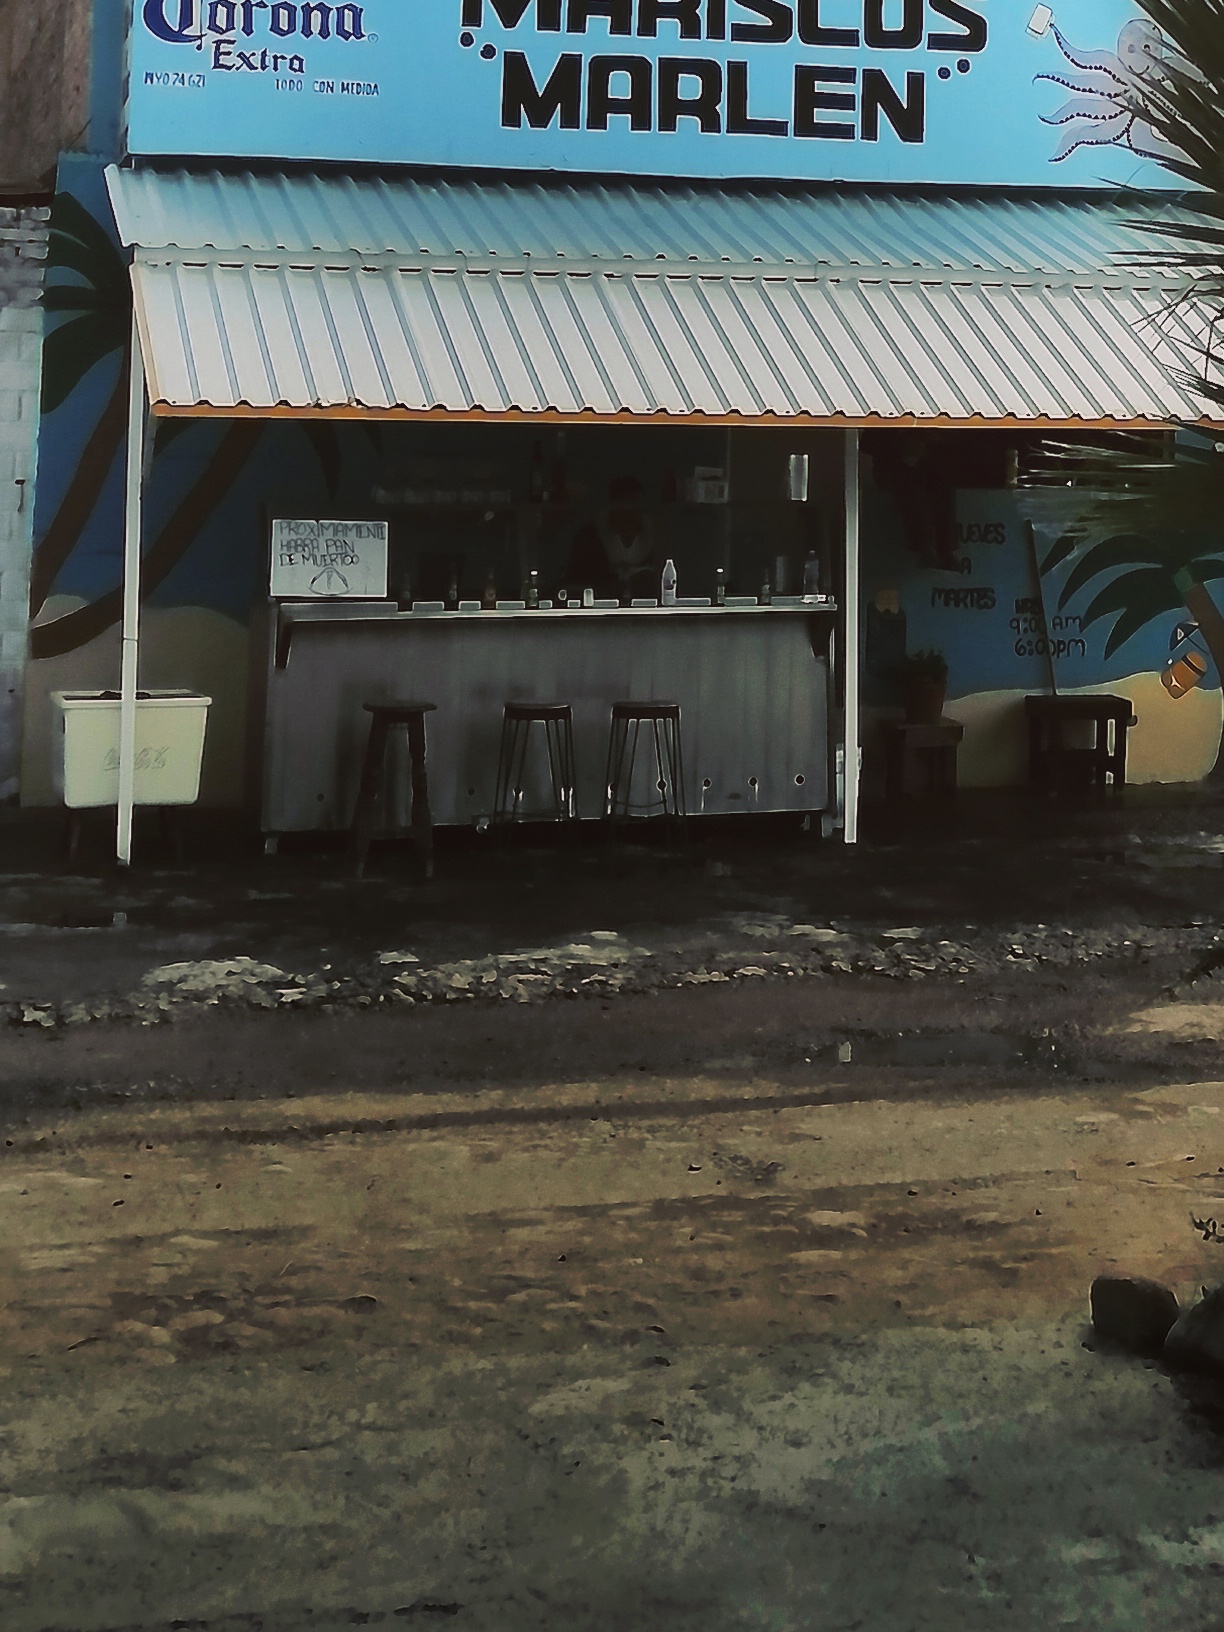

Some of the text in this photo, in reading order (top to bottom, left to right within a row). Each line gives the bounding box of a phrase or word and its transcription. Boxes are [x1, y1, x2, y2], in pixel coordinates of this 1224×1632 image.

[211, 39, 305, 74] Extra
[275, 78, 379, 96] TODO CON MEDIDA
[501, 50, 925, 143] MARLEN
[957, 522, 1006, 545] UEVES
[325, 538, 355, 554] PAN
[279, 553, 299, 567] DE
[960, 556, 972, 574] A
[931, 586, 997, 610] MARTES
